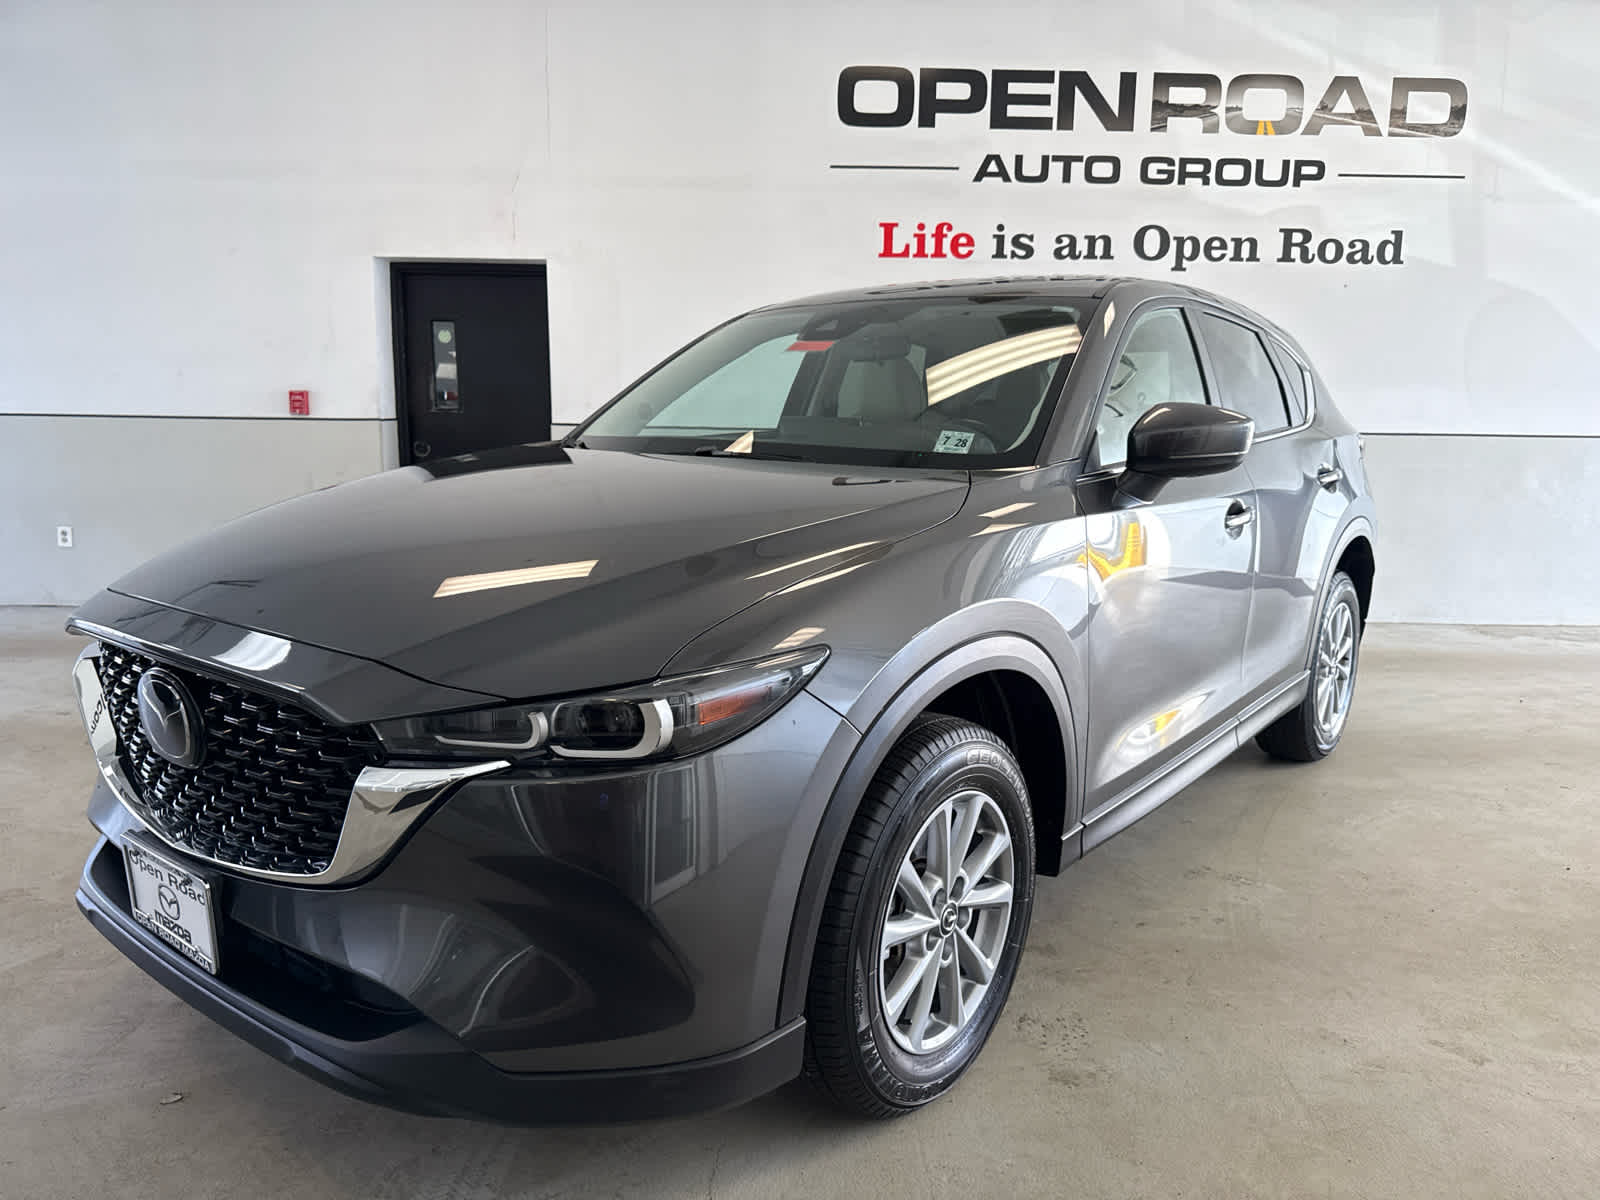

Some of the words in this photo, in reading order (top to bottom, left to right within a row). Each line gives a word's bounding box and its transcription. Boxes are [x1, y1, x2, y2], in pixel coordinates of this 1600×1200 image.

[837, 65, 1137, 132] OPEN
[1150, 71, 1468, 138] ROAD
[972, 153, 1121, 185] AUTO
[1139, 156, 1326, 188] GROUP
[878, 221, 975, 259] Life
[991, 223, 1035, 260] is
[1053, 234, 1114, 261] an
[1133, 224, 1260, 272] Open
[1276, 228, 1404, 266] Road
[943, 436, 951, 445] 7
[954, 438, 968, 448] 28
